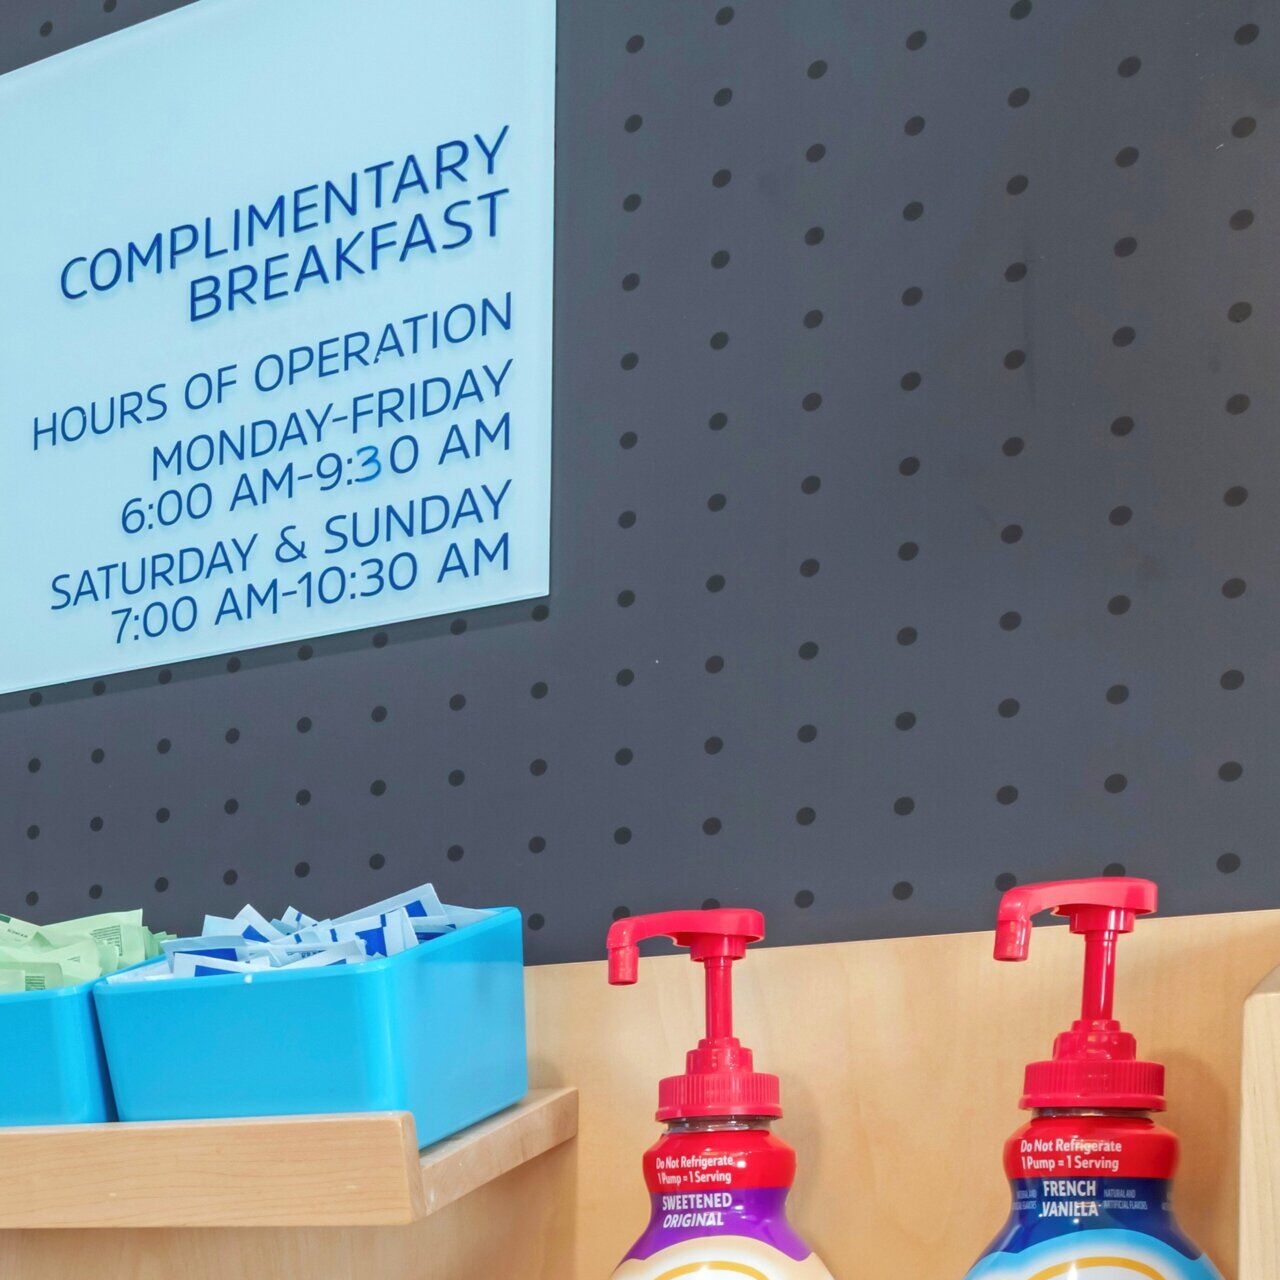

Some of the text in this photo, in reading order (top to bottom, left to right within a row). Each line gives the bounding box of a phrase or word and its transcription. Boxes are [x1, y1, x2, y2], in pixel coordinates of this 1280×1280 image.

[60, 125, 510, 301] COMPLIMENTARY
[190, 188, 509, 322] BREAKFAST
[33, 291, 512, 450] HOURS OF OPERATION
[152, 359, 513, 480] MONDAY-FRIDAY
[121, 412, 511, 534] 6:00 AM-9:30 AM
[51, 479, 512, 610] SATURDAY & SUNDAY
[111, 532, 510, 644] 7:00 AM-10:30 AM
[1020, 1138, 1122, 1155] Do Not Refrigerate
[656, 1155, 734, 1170] Do Not Refrigerate
[1021, 1156, 1026, 1170] 1
[1026, 1156, 1056, 1172] Pump
[1066, 1155, 1072, 1168] 1
[1074, 1155, 1120, 1172] Serving
[661, 1172, 682, 1186] Pump
[689, 1171, 693, 1183] 1
[694, 1170, 732, 1184] Serving
[1042, 1180, 1097, 1197] FRENCH
[662, 1192, 733, 1211] SWEETENED
[1042, 1201, 1100, 1217] VANILLA
[663, 1211, 724, 1229] ORIGINAL
